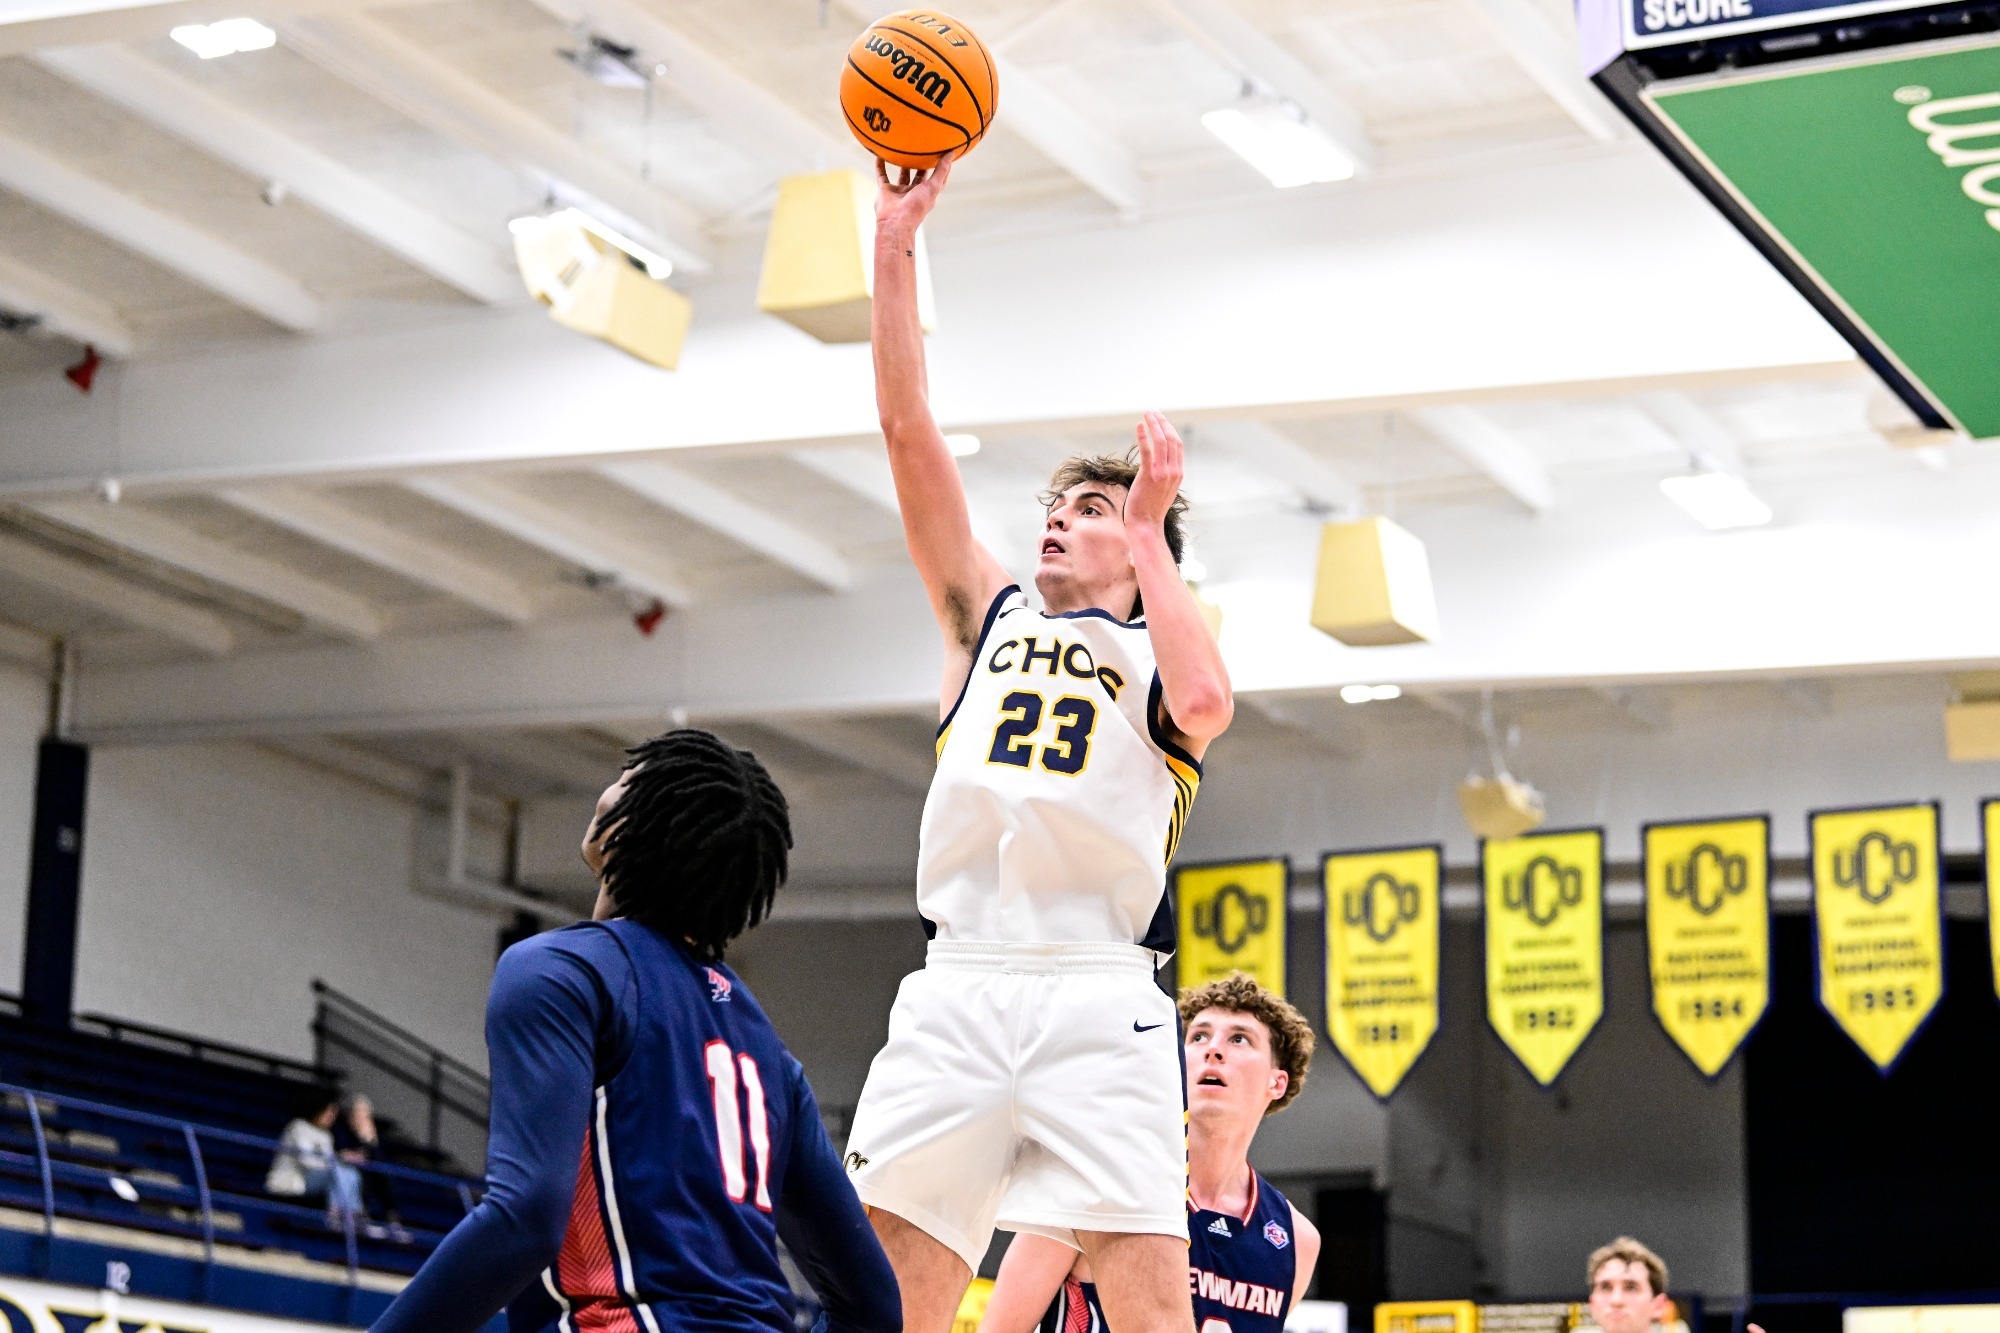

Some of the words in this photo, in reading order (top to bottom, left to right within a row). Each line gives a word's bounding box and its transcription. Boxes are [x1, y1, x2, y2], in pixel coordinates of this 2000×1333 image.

[864, 34, 951, 109] Wilson
[985, 688, 1100, 778] 23
[1502, 855, 1583, 927] UCO
[1664, 843, 1748, 916] UCO
[1833, 831, 1918, 905] UCO
[1343, 872, 1420, 943] UCO
[704, 1038, 773, 1213] 11
[1189, 1266, 1285, 1318] EWMAN
